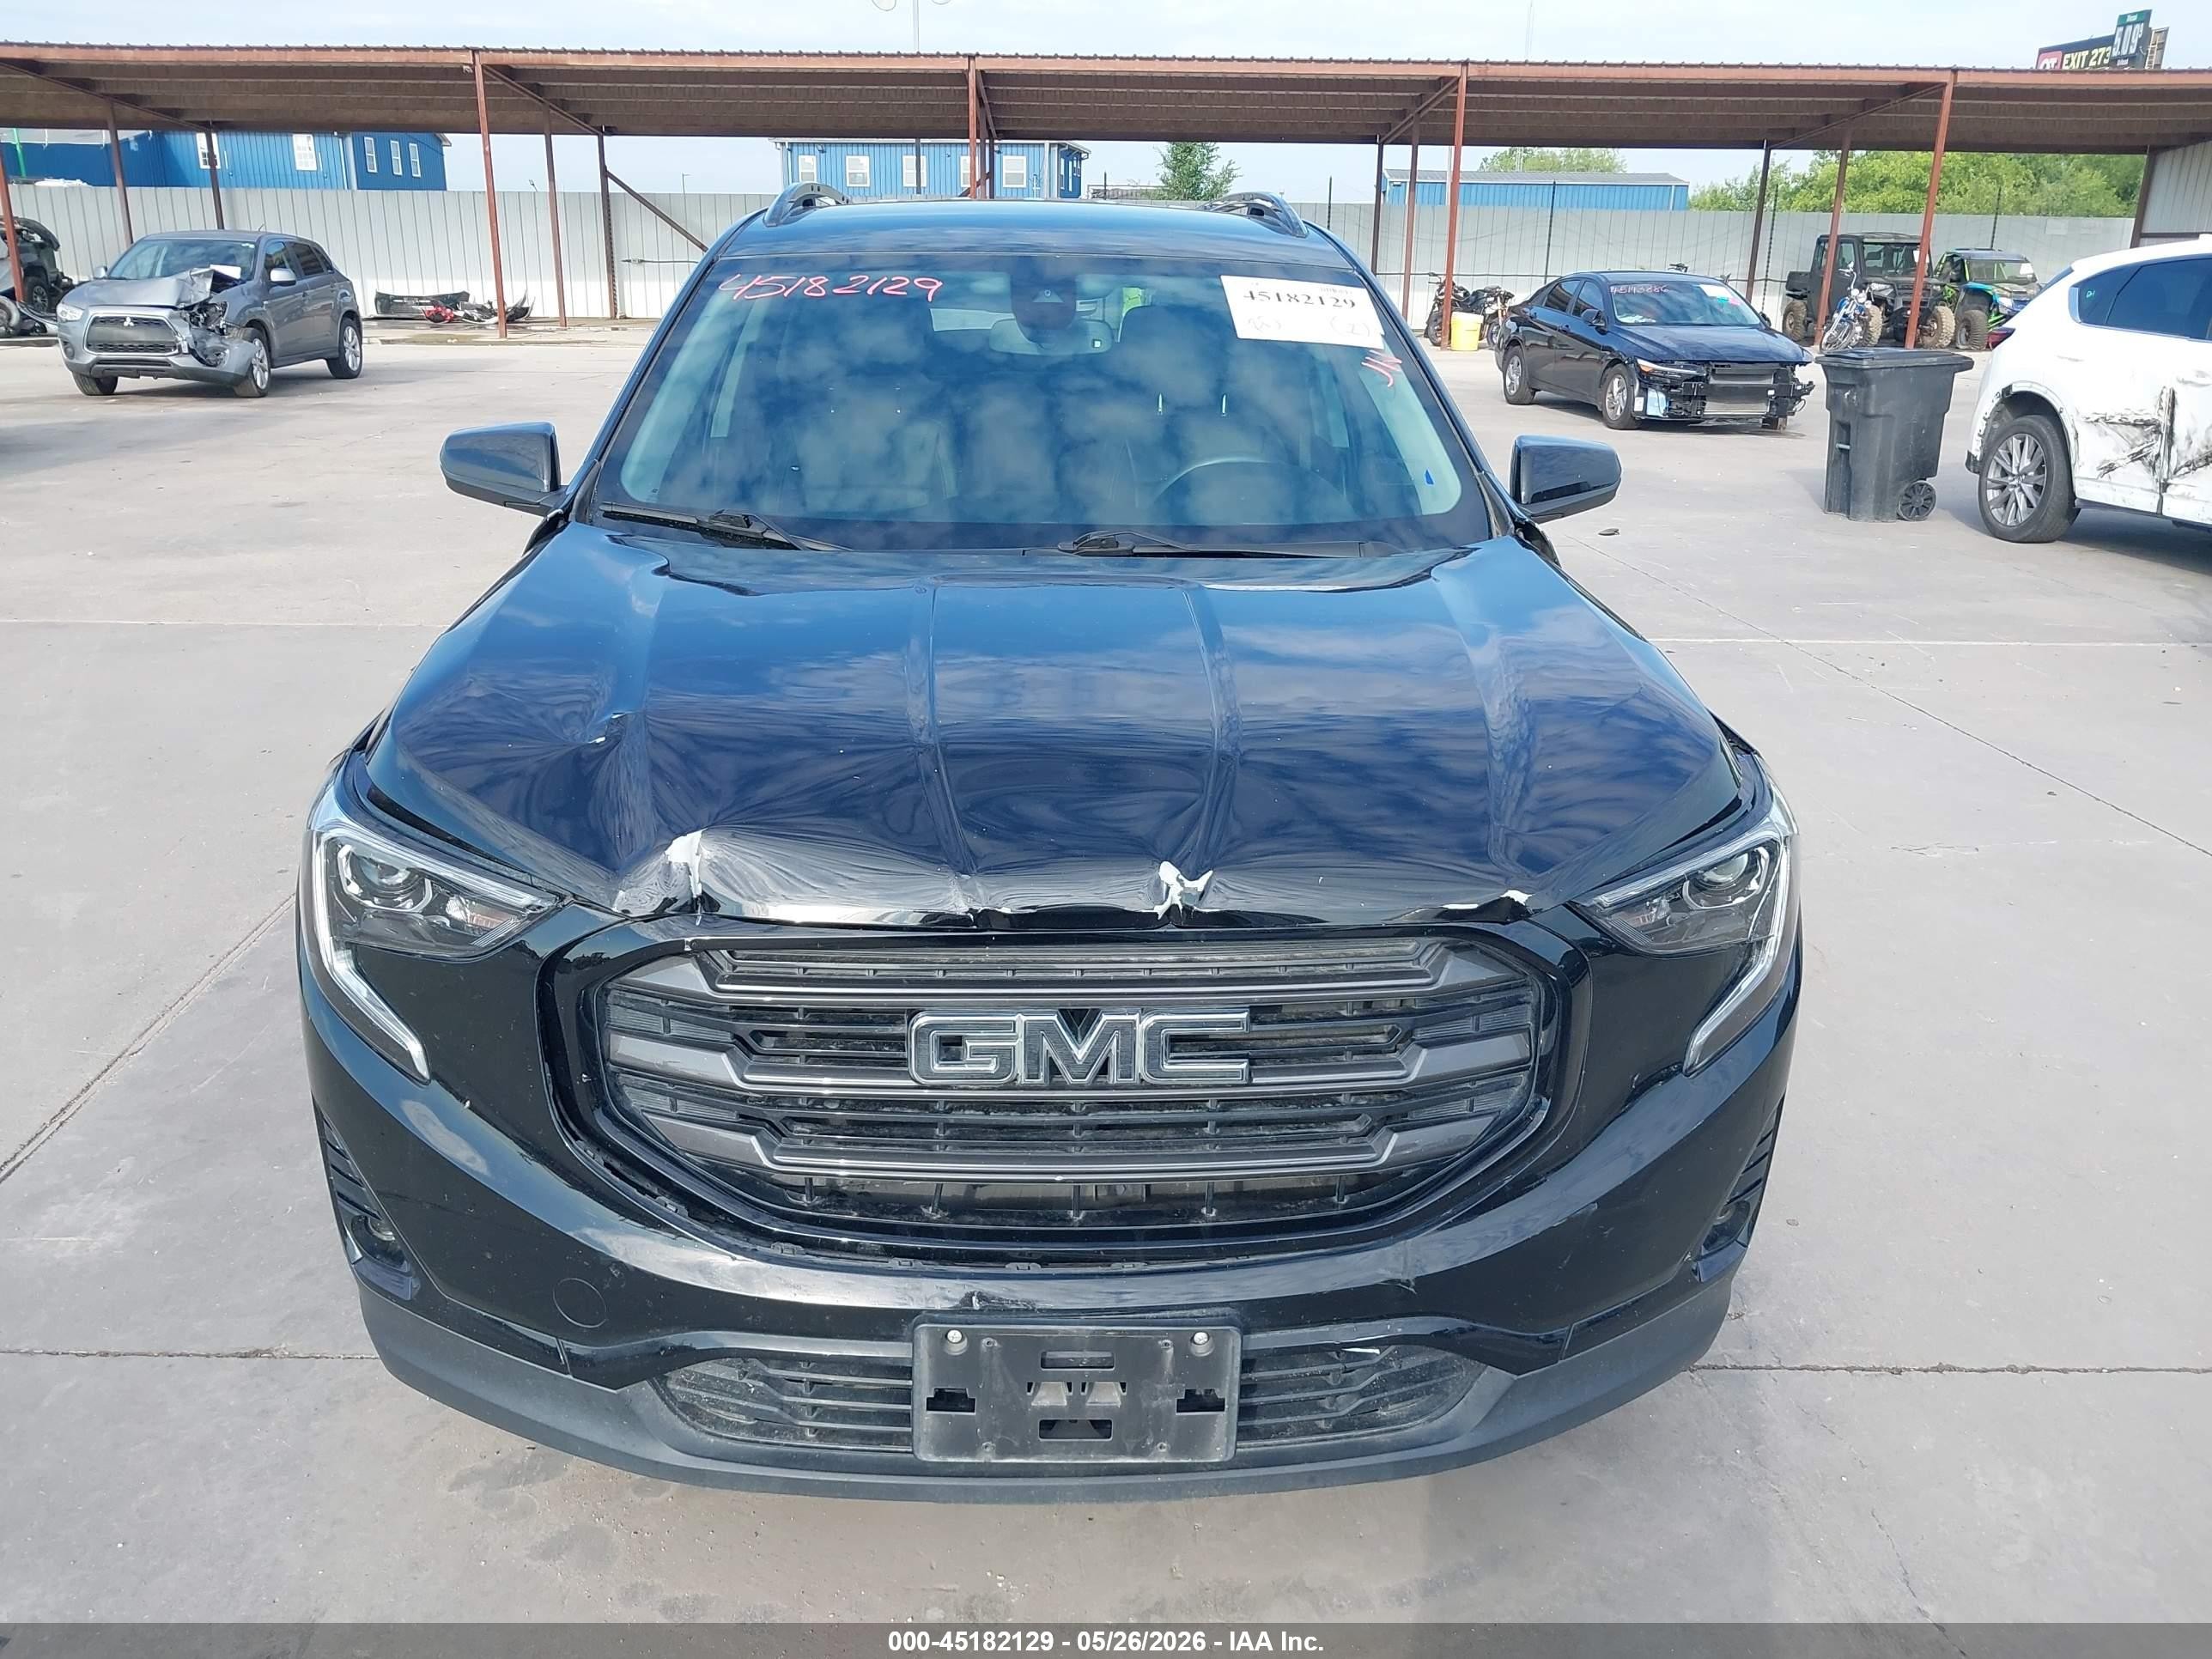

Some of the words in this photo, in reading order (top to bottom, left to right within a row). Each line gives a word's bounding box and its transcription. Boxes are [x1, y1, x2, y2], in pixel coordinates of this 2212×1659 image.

[2062, 50, 2089, 70] EXIT
[2088, 46, 2112, 67] 273
[1243, 289, 1358, 309] 45182129
[906, 1007, 1251, 1086] GMC
